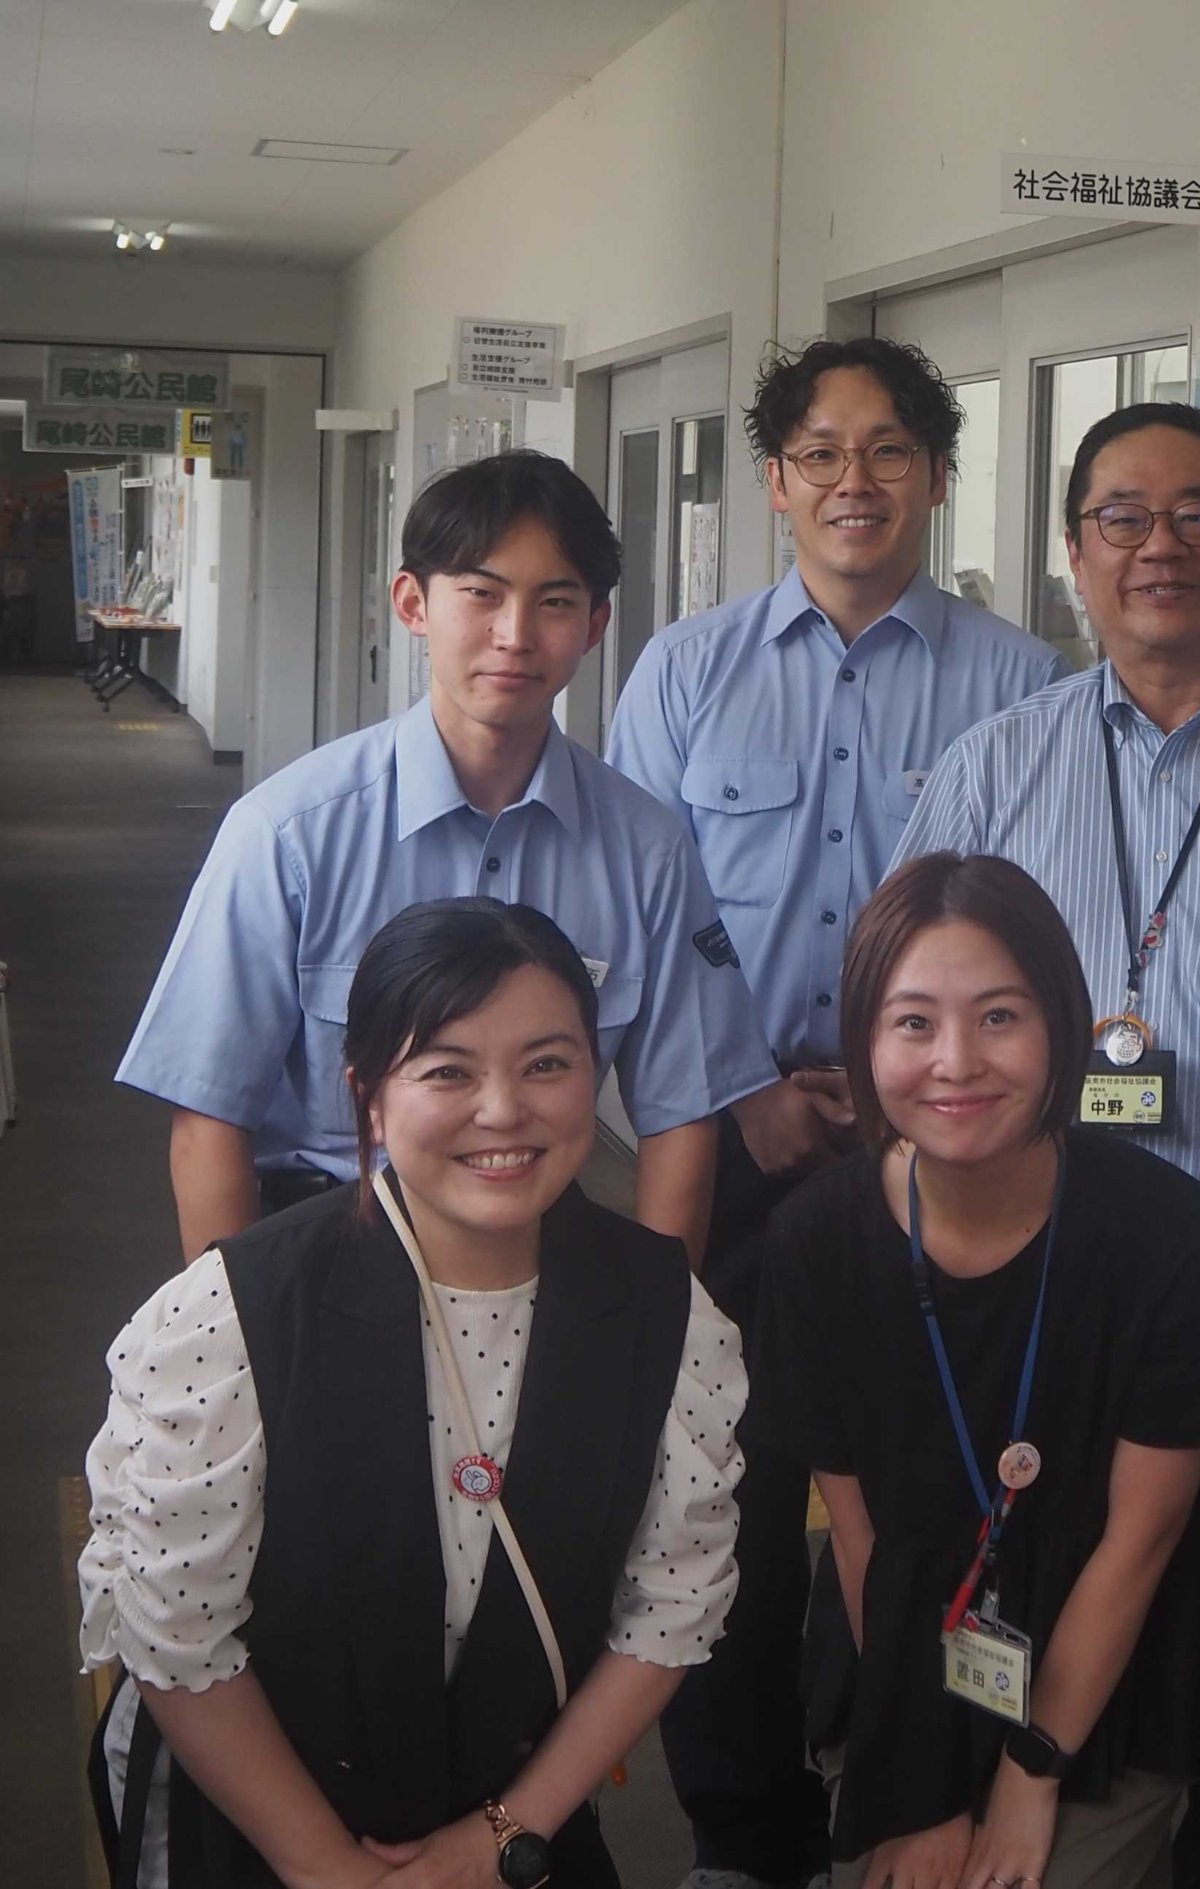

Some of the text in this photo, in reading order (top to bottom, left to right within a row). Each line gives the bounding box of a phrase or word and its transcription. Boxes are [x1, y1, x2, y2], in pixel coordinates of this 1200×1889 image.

[60, 367, 218, 402] 尾崎公民館
[36, 420, 166, 449] 尾崎公民館
[1091, 1099, 1124, 1116] 中野
